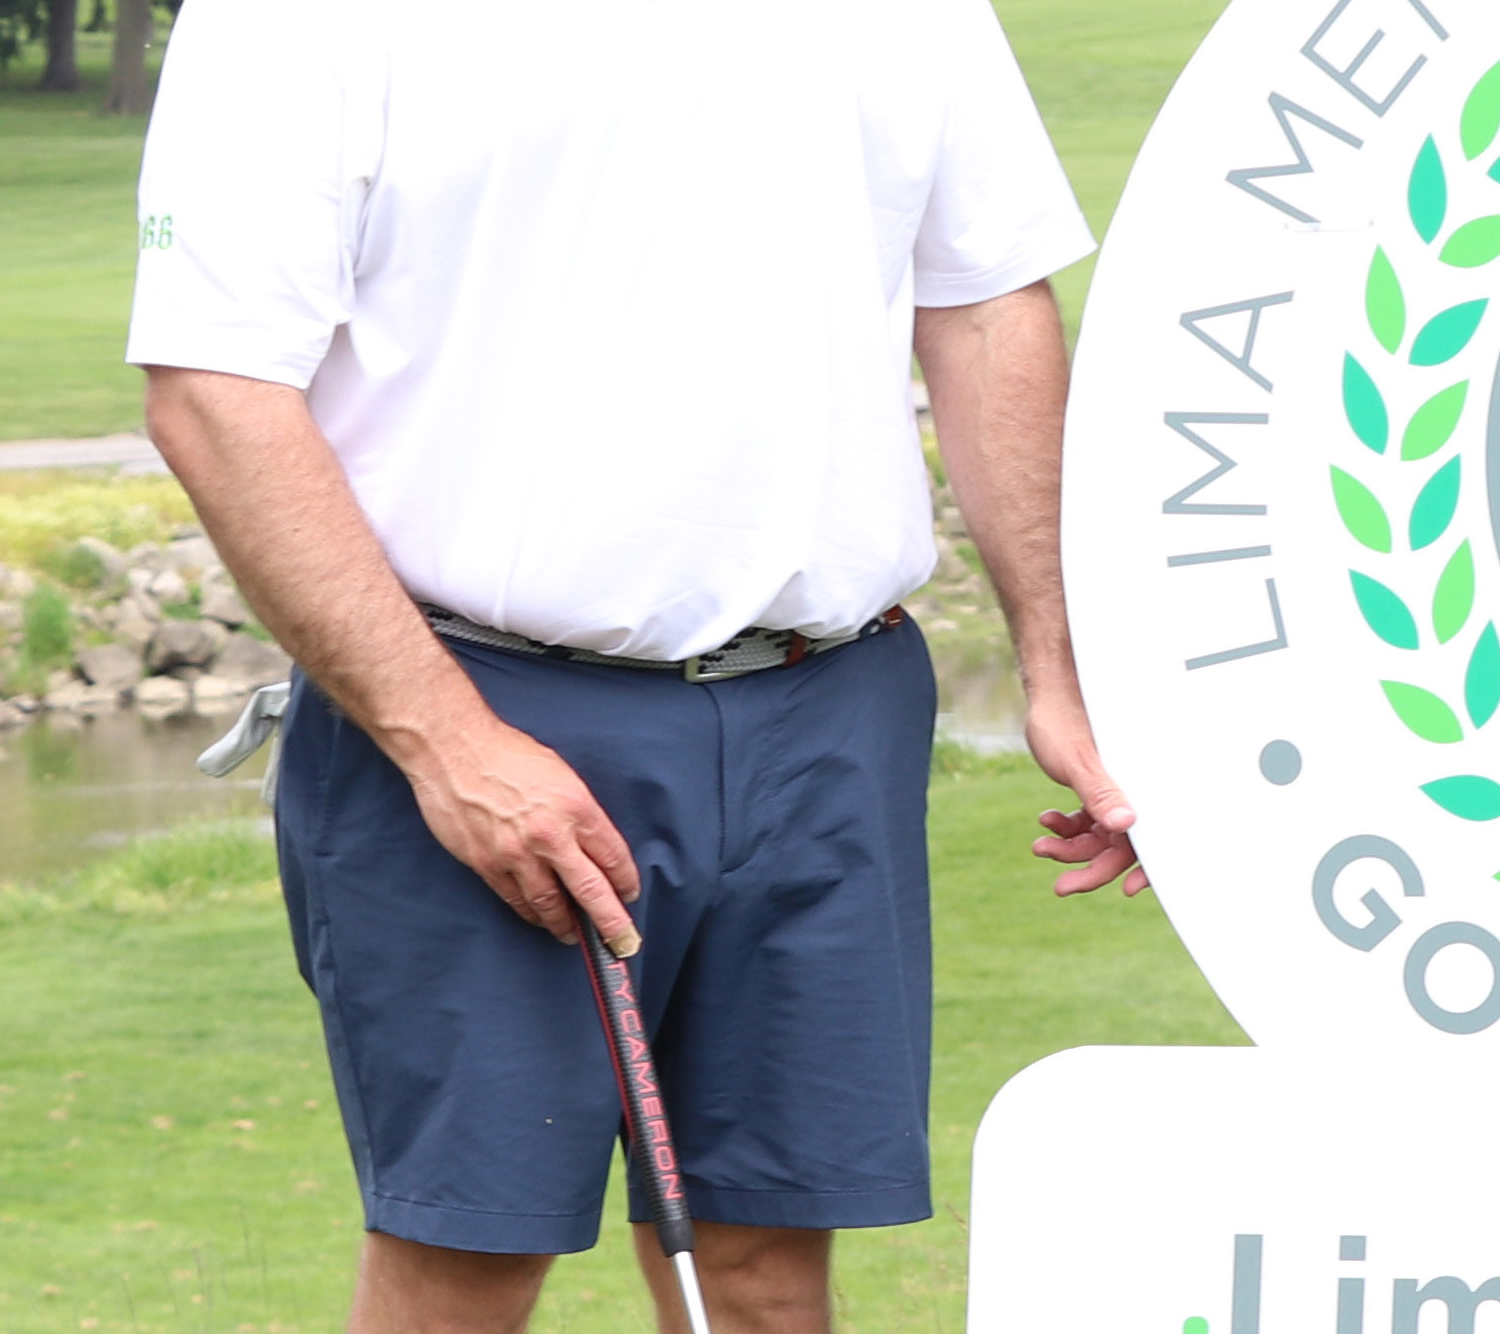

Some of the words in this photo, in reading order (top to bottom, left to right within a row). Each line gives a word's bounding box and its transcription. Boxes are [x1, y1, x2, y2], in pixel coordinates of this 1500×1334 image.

[1161, 290, 1295, 672] LIMA
[607, 961, 638, 1004] TY
[618, 1008, 684, 1201] CAMERON
